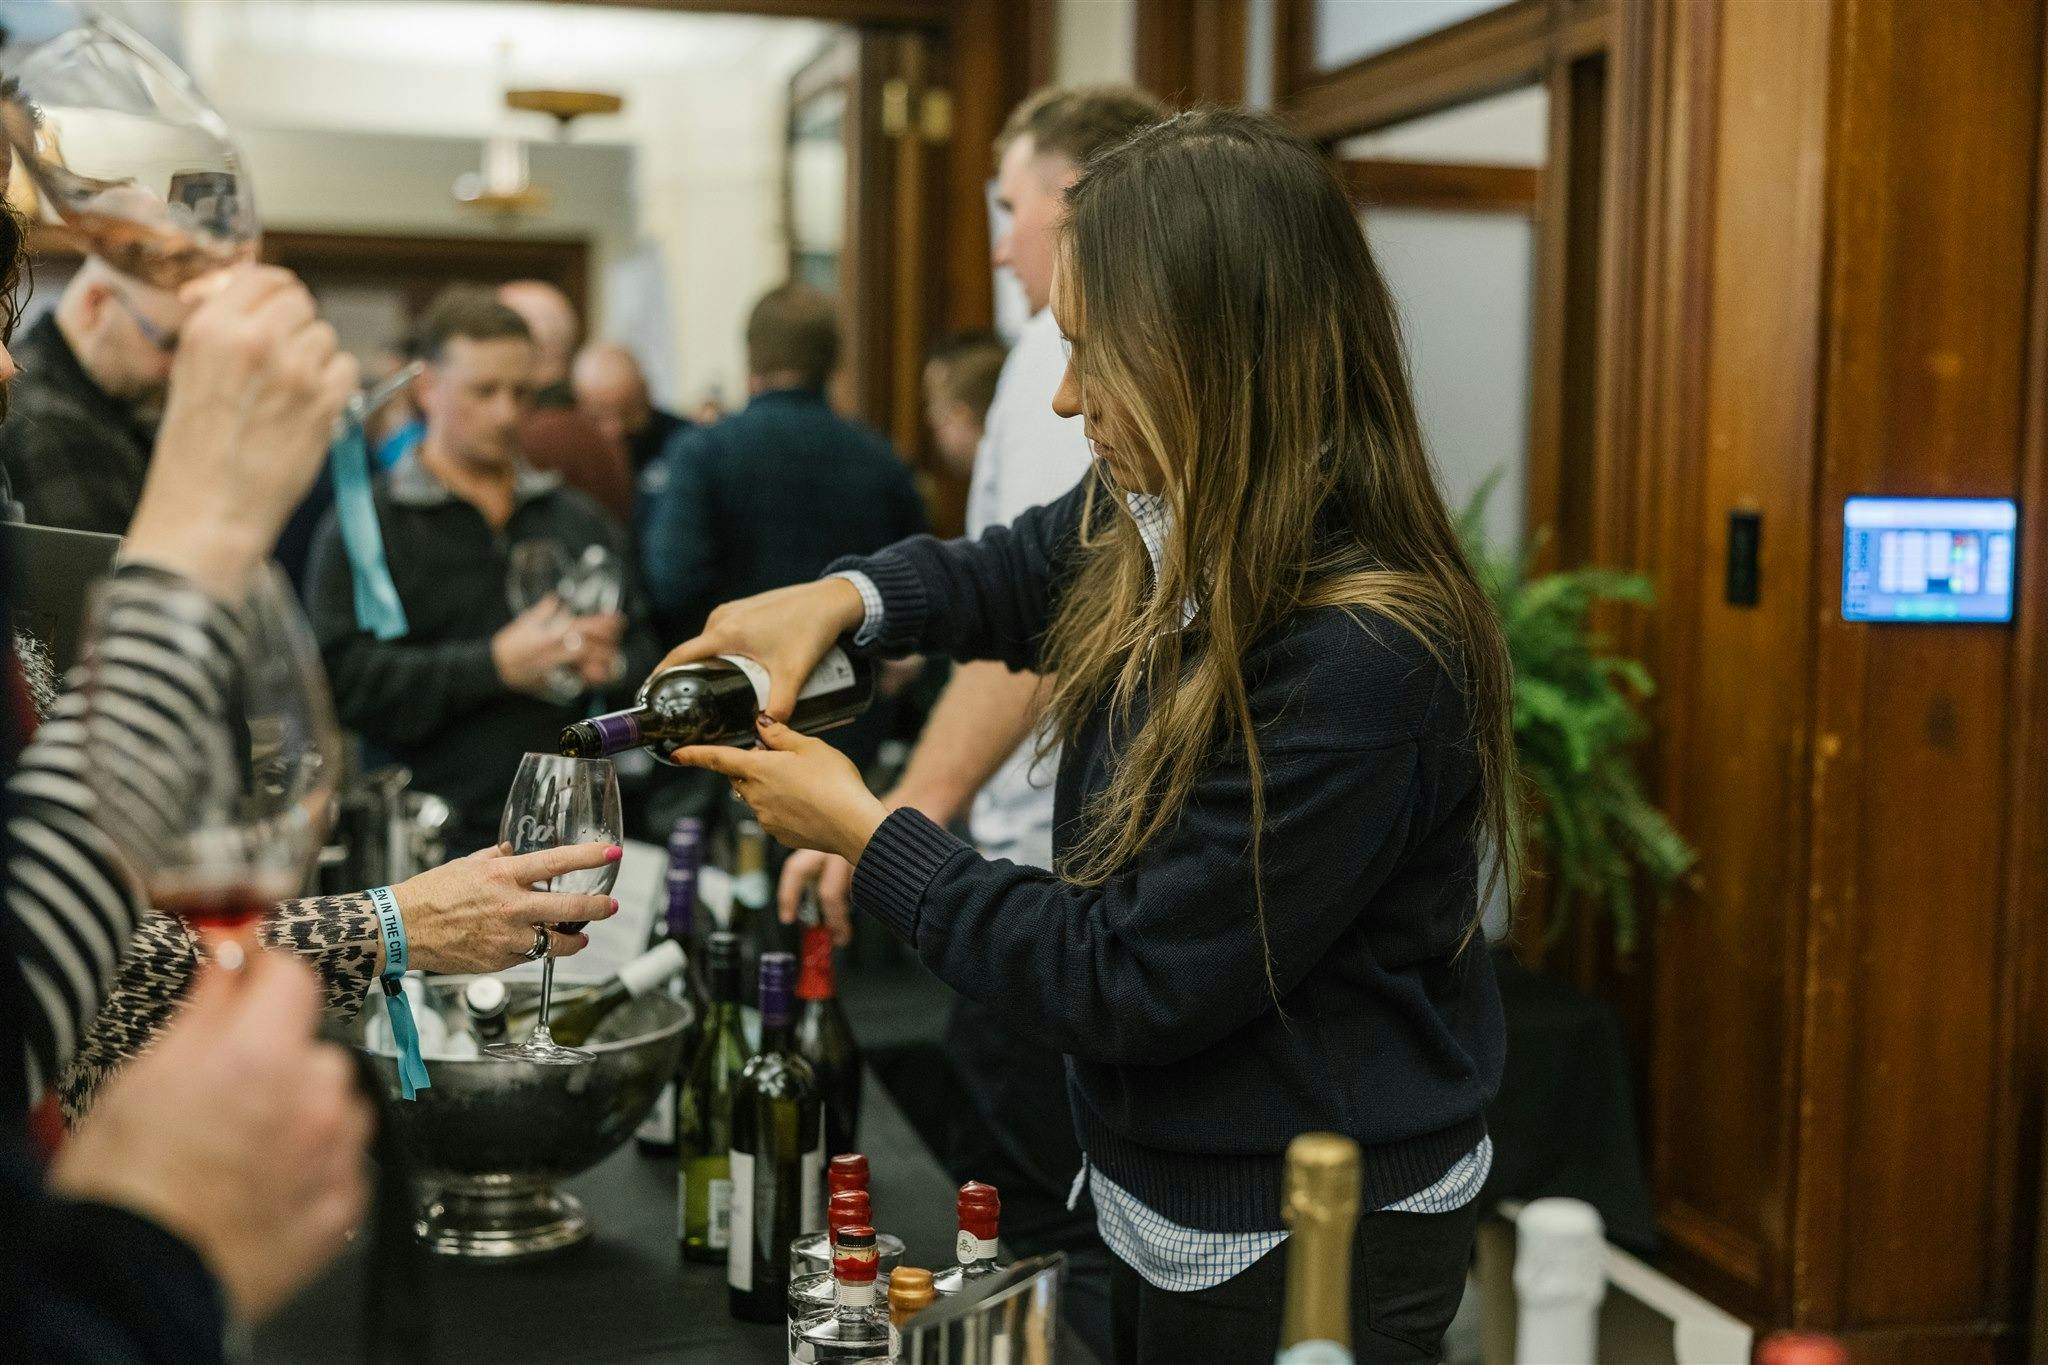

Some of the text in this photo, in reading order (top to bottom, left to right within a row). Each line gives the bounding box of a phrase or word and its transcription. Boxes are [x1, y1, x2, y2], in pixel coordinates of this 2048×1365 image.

[380, 902, 393, 913] IN
[385, 915, 399, 939] THE
[389, 940, 402, 964] CITY
